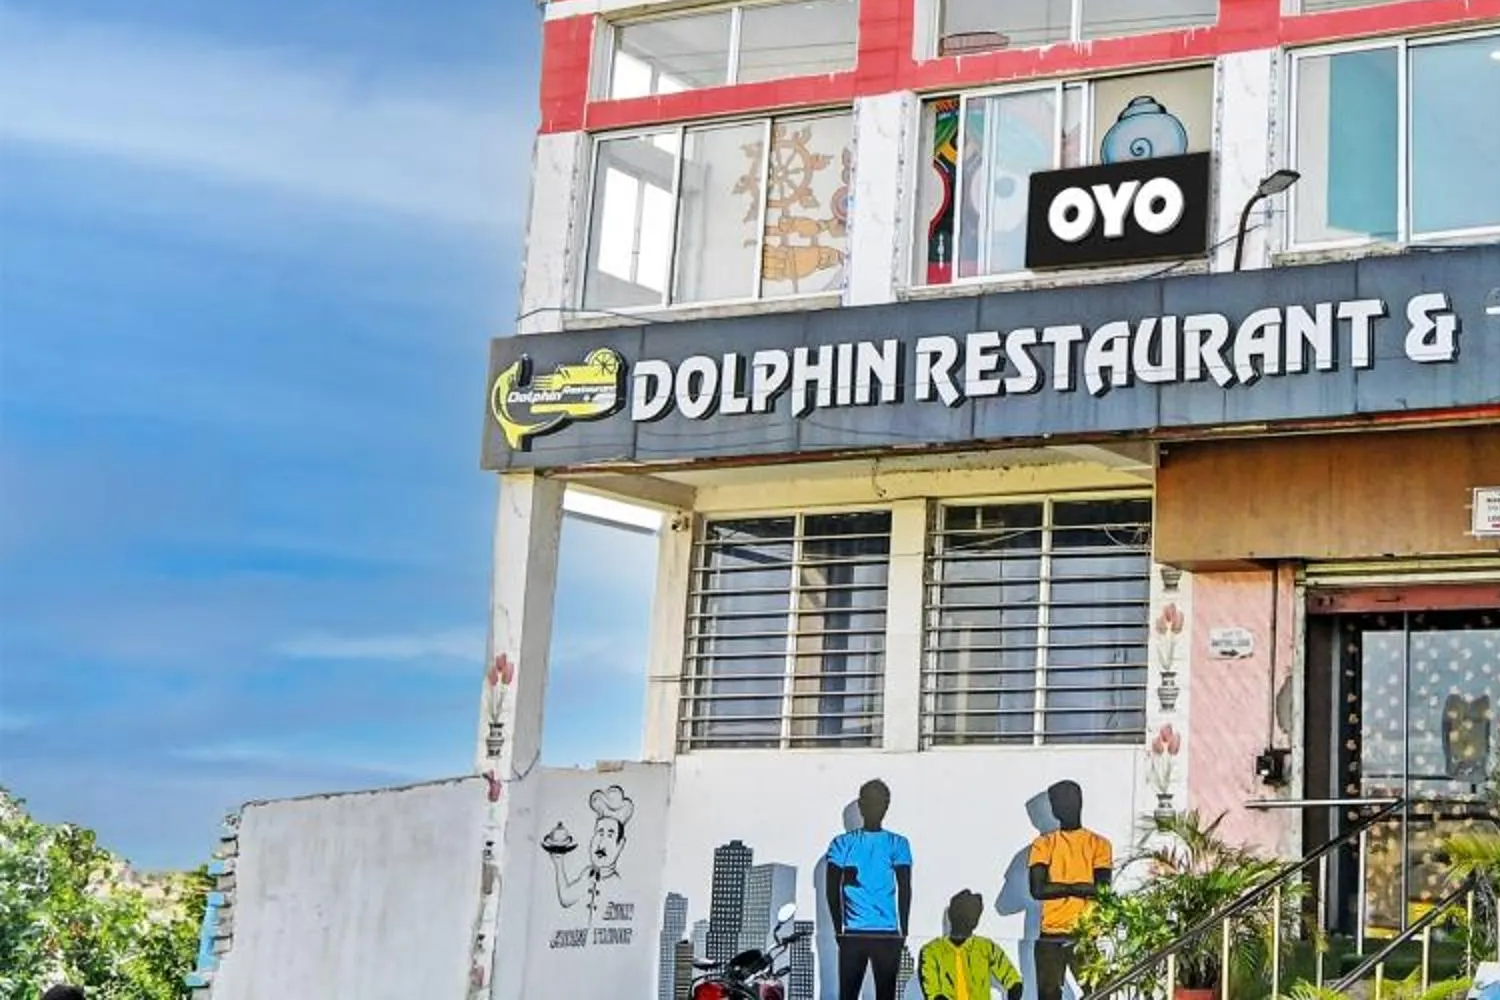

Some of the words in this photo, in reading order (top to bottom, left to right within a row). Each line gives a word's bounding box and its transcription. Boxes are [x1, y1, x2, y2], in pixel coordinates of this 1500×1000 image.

[1049, 177, 1184, 241] OYO
[630, 339, 898, 421] DOLPHIN
[915, 299, 1384, 407] RESTAURANT
[1404, 291, 1457, 363] &
